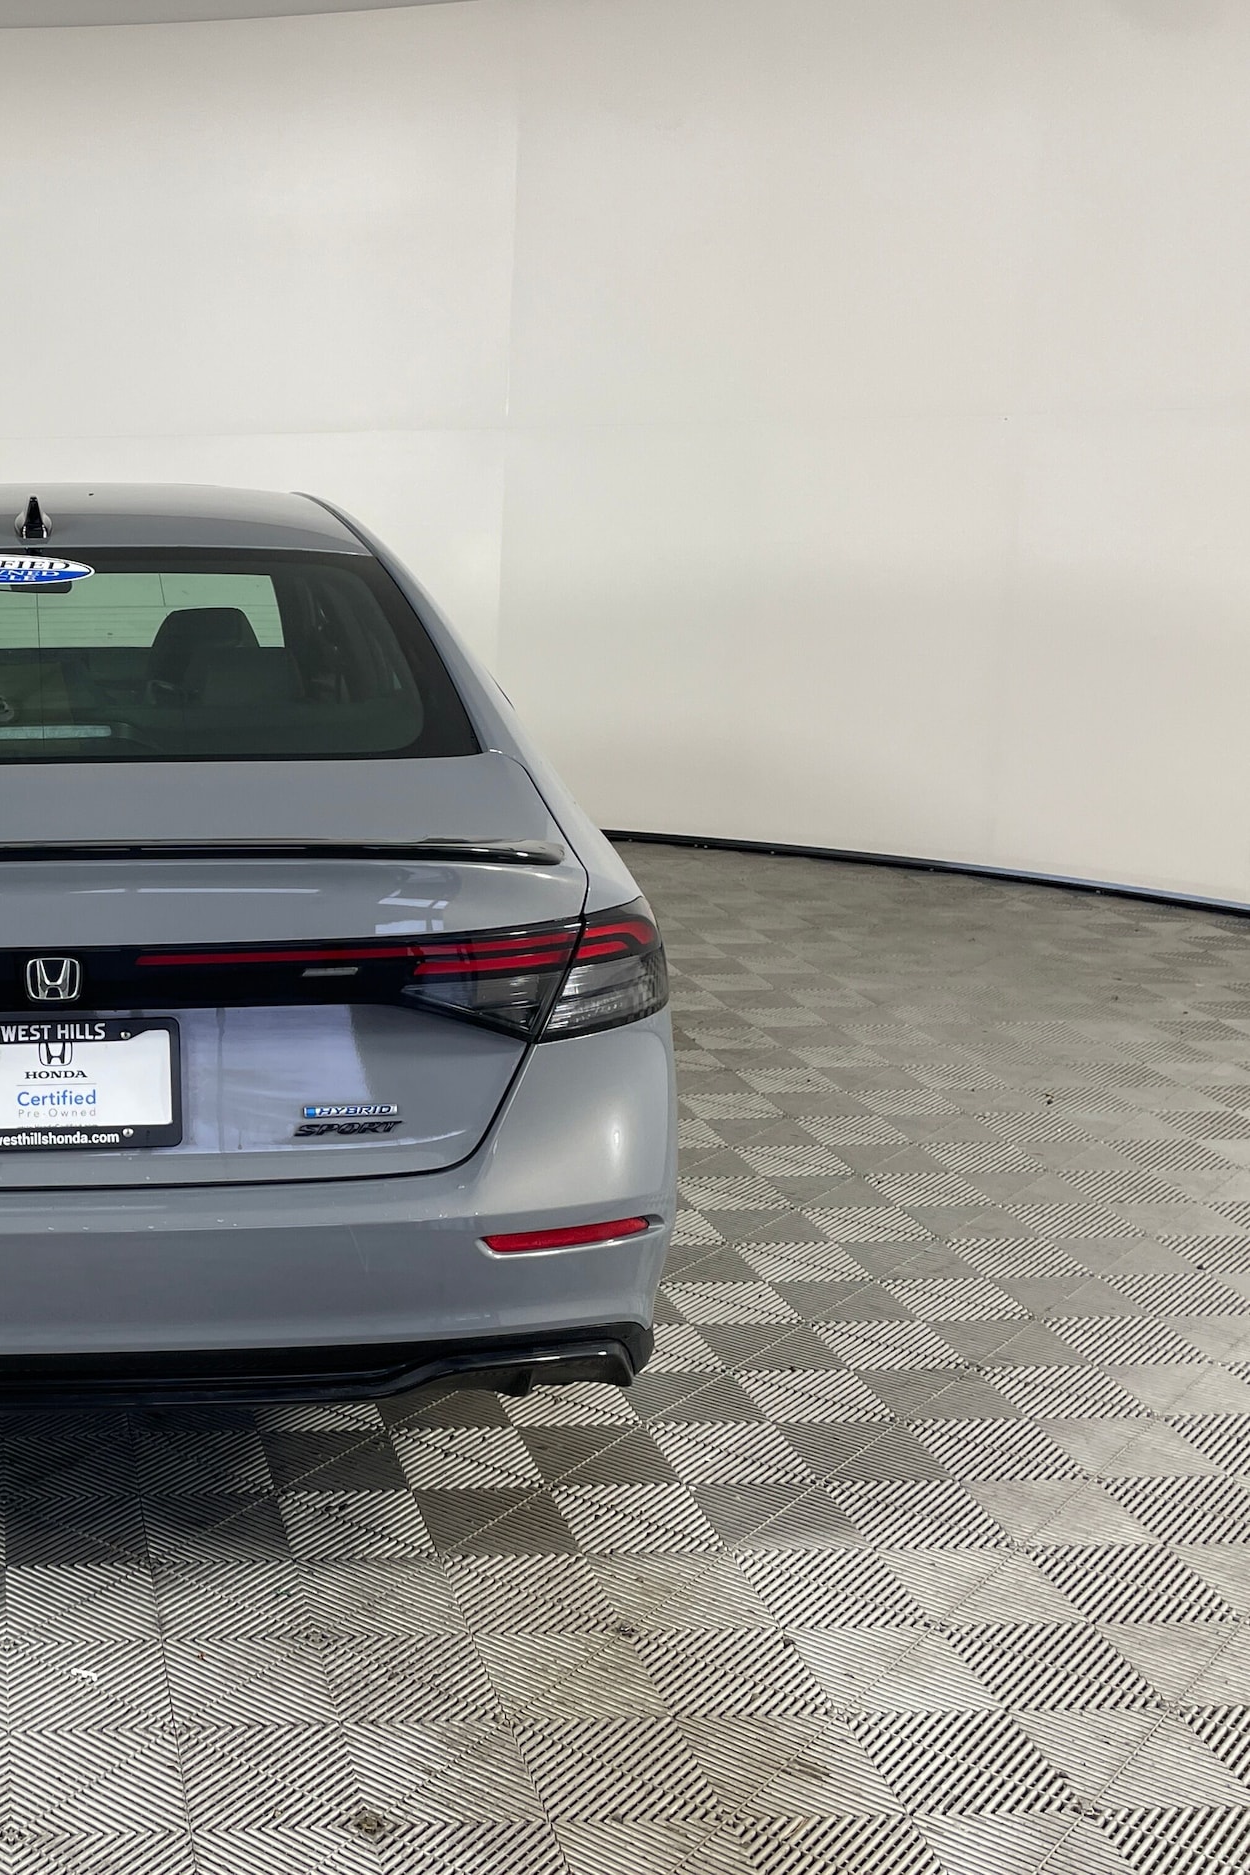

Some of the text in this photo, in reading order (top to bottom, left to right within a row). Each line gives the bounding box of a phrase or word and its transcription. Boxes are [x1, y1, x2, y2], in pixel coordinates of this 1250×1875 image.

[0, 1023, 106, 1042] WEST HILLS
[25, 1070, 87, 1080] HONDA
[17, 1089, 97, 1107] Certified
[18, 1107, 97, 1119] Pre-Owned
[318, 1105, 392, 1116] HYBRID
[293, 1120, 403, 1137] SPORT
